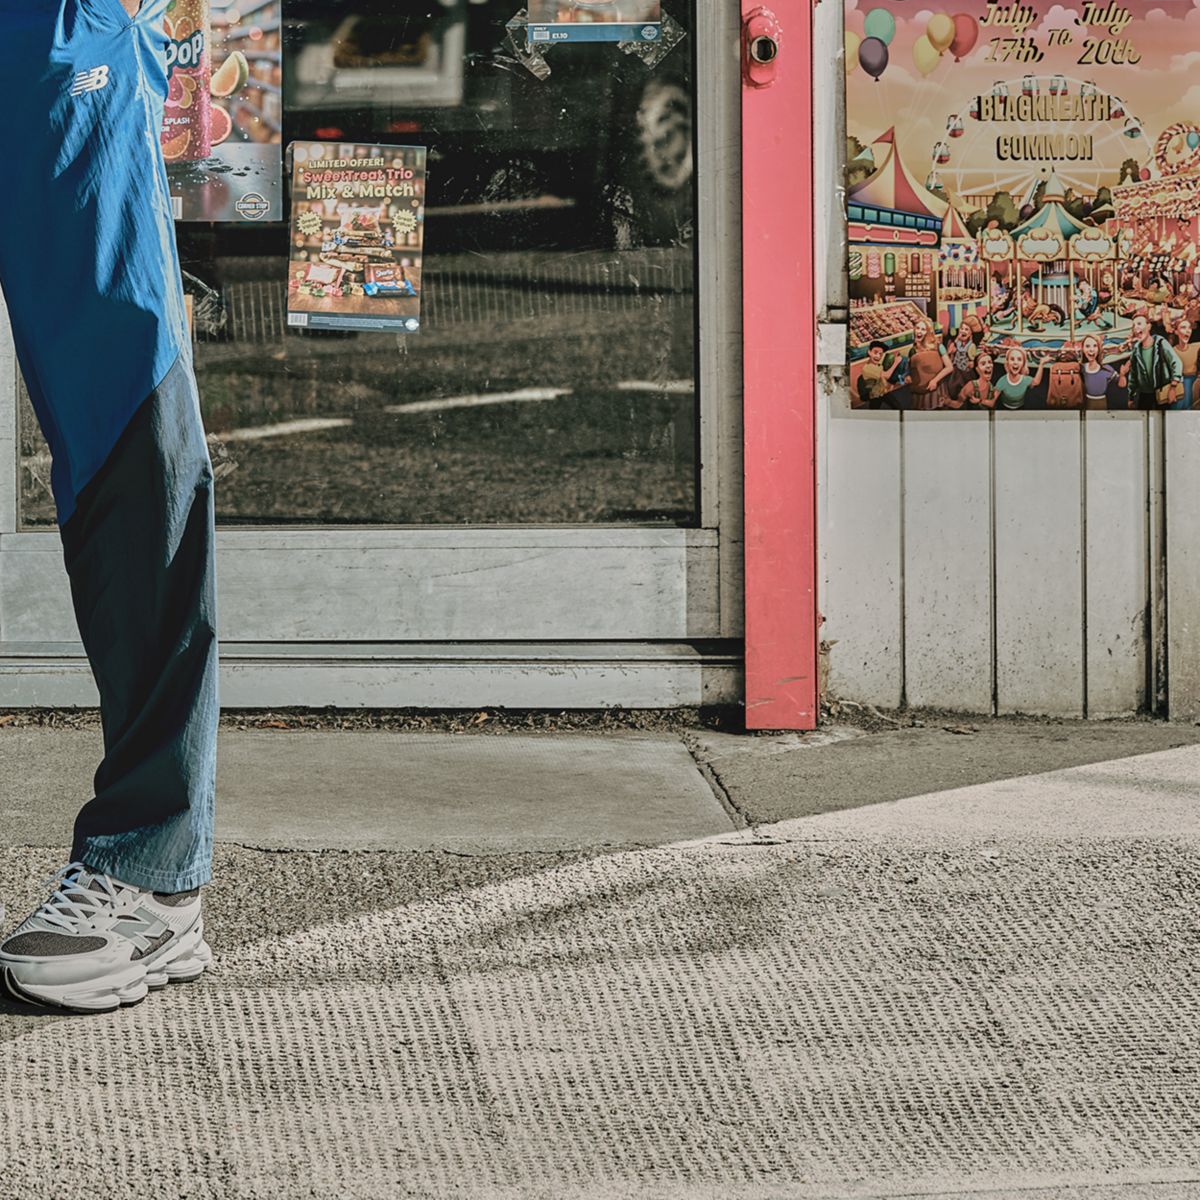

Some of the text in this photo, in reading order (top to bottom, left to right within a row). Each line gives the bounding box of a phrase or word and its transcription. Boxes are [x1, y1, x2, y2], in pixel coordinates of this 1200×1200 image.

[1074, 0, 1133, 35] July
[308, 157, 385, 170] LIMITED OFFER!
[303, 168, 414, 184] SweetTreat Trio
[306, 183, 415, 200] Mix & Match
